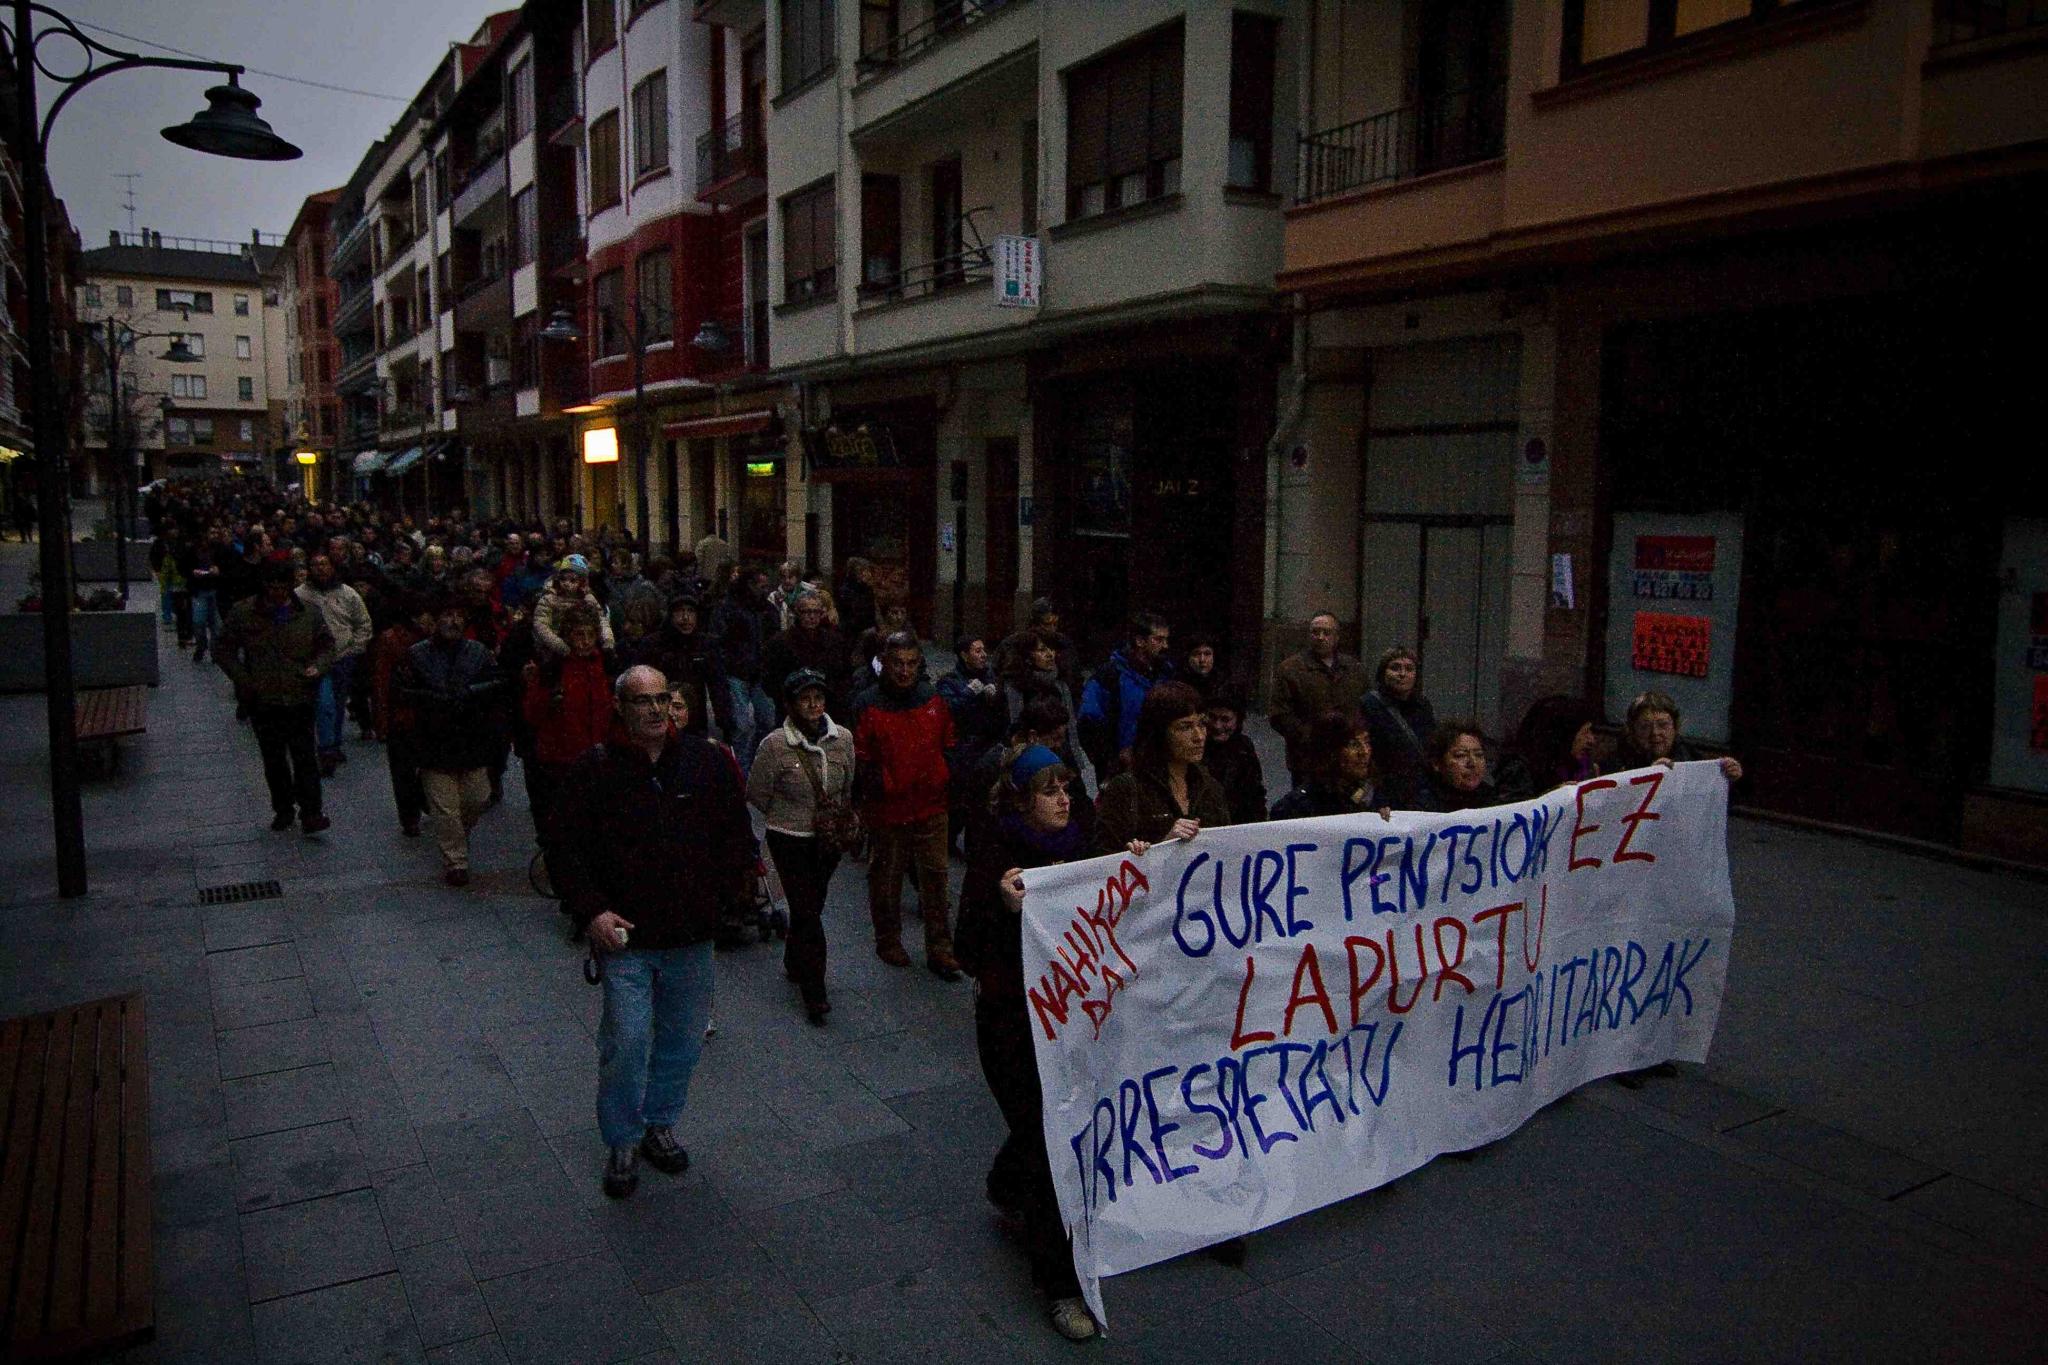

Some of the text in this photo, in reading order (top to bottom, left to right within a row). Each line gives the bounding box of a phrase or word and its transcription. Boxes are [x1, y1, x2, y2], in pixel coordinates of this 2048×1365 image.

[1028, 859, 1150, 1041] NAHIKOA
[1172, 843, 1318, 957] GURE
[1569, 772, 1664, 872] EZ
[1231, 884, 1547, 1050] LAPURTU
